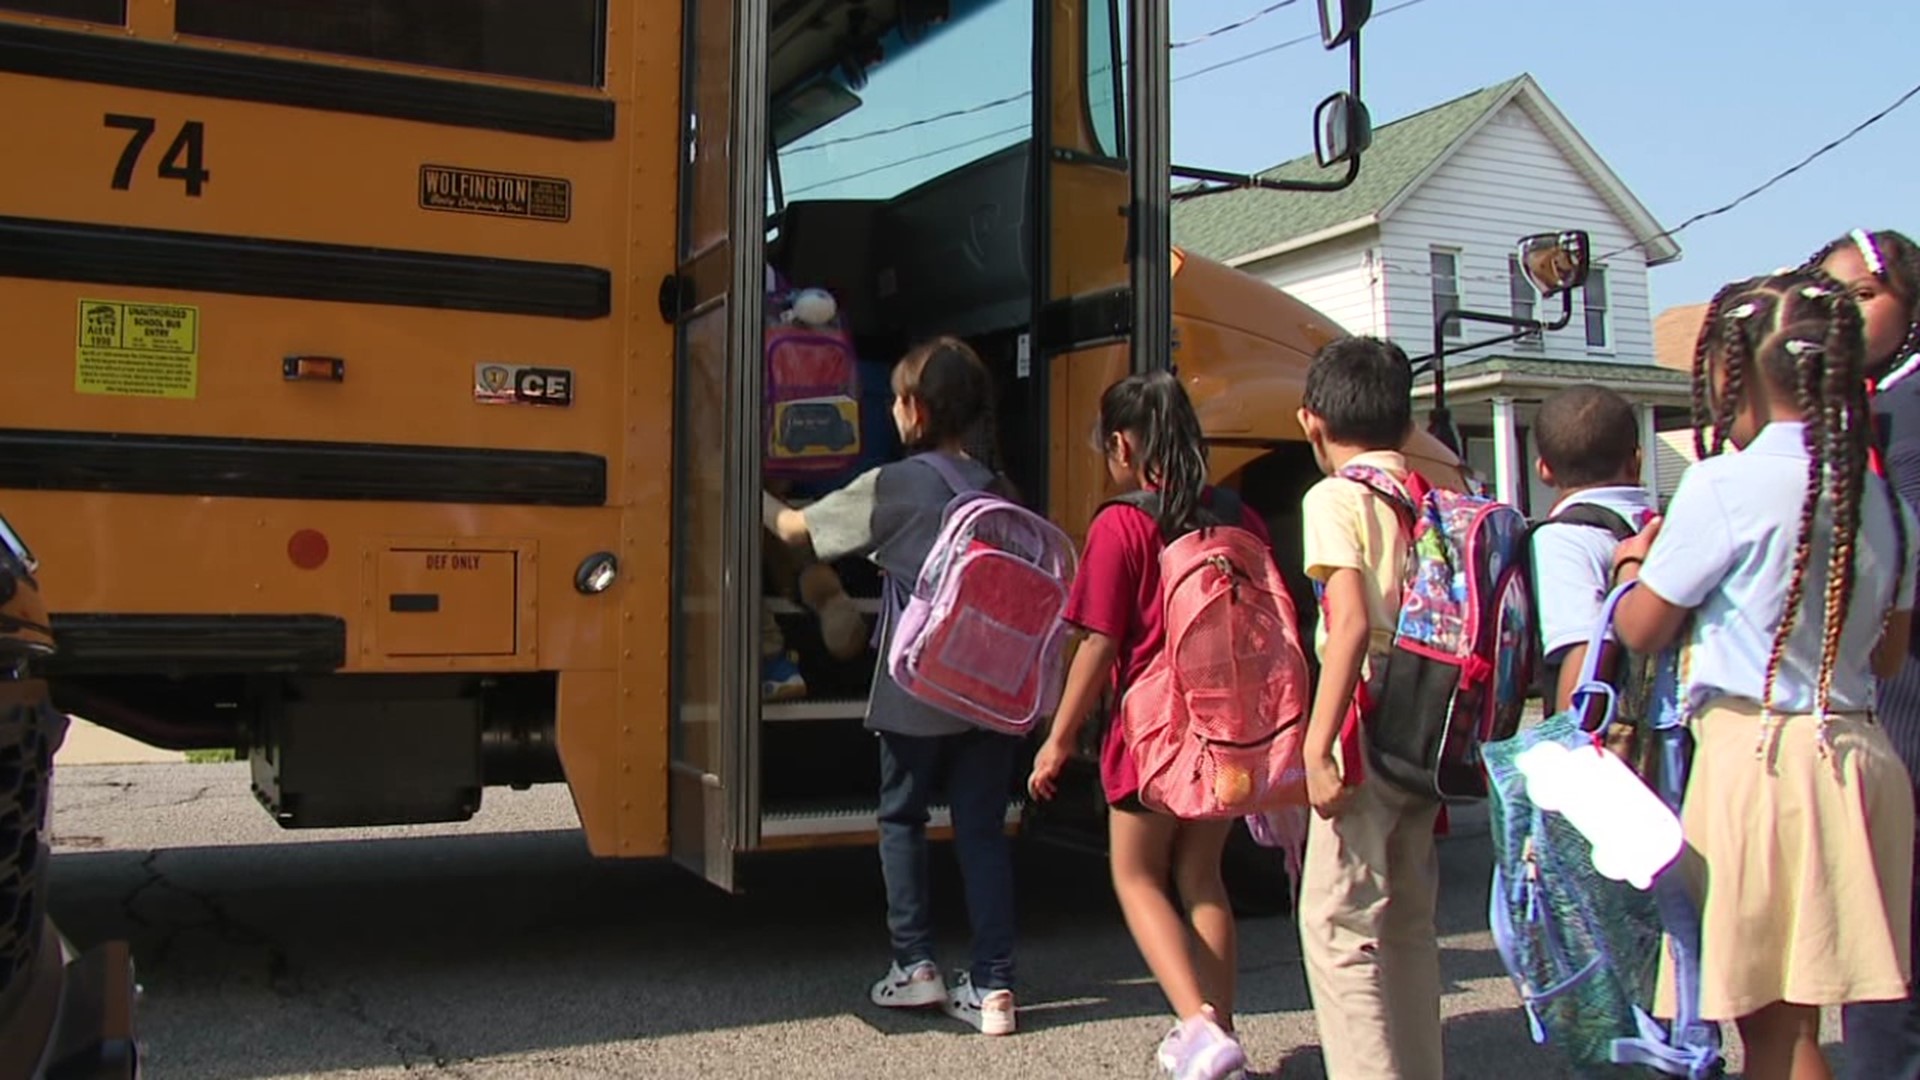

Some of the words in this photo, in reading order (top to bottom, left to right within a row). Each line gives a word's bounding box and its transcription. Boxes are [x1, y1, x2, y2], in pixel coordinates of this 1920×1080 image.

[104, 113, 210, 197] 74
[426, 171, 526, 202] WOLFINGTON
[129, 308, 187, 318] UNAUTHORIZED
[134, 318, 163, 327] SCHOOL
[166, 320, 181, 328] BUS
[145, 328, 169, 336] ENTRY
[521, 375, 566, 398] CE
[426, 555, 448, 570] DEF
[452, 556, 480, 570] ONLY
